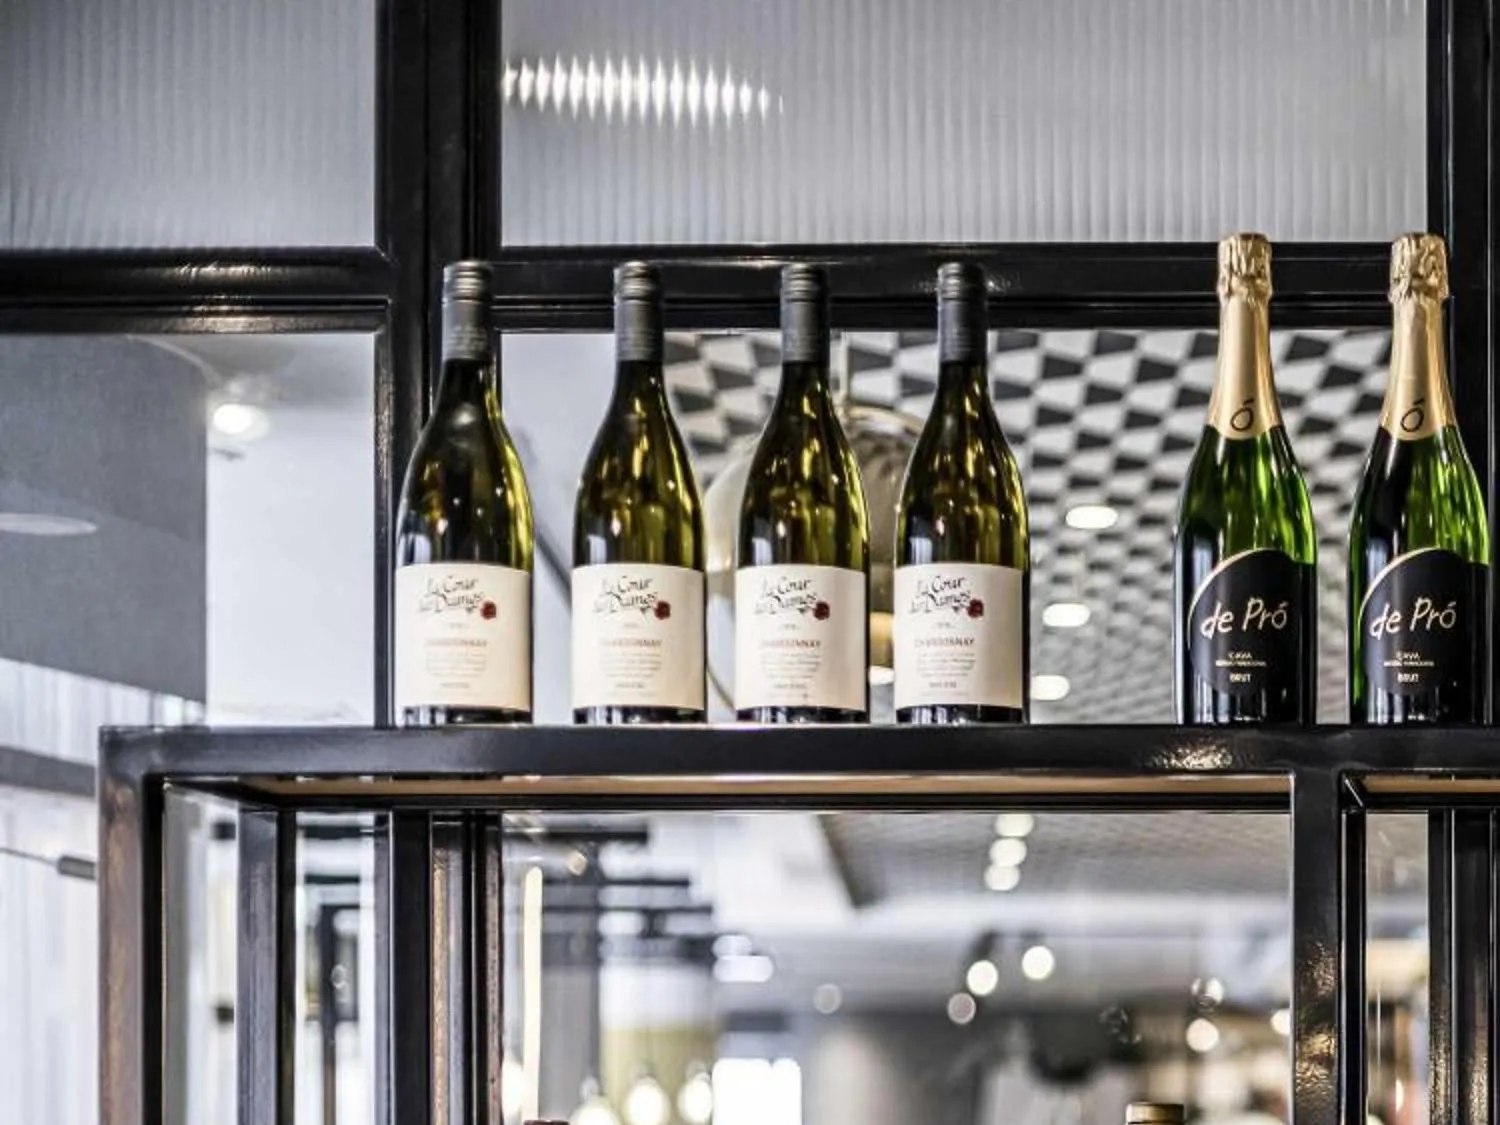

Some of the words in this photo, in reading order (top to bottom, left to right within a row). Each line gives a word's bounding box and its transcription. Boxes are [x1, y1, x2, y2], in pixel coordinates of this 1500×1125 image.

[1201, 602, 1234, 639] de
[1242, 597, 1289, 631] Pró
[1369, 602, 1402, 640] de
[1409, 597, 1457, 631] Pró
